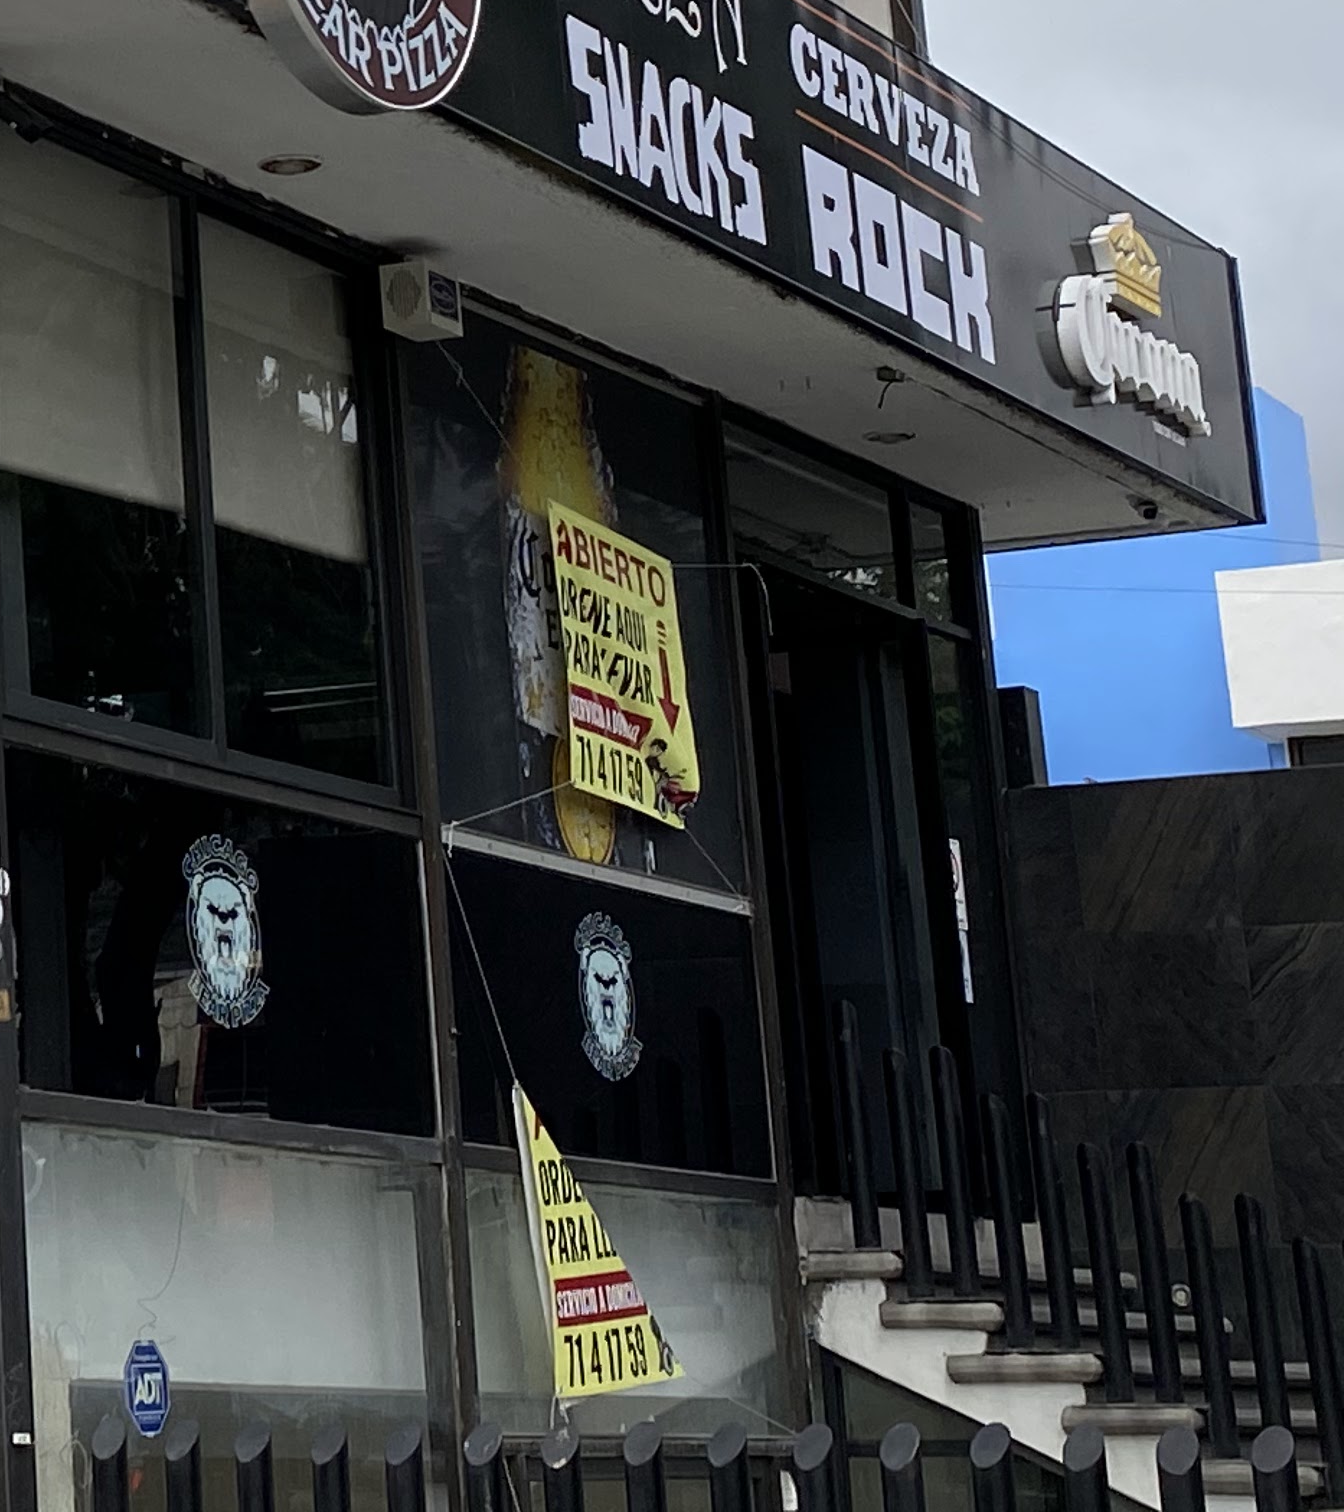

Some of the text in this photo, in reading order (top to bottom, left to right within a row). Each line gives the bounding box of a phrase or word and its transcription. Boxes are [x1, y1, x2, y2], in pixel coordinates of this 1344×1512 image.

[379, 1, 468, 92] PIZZA
[565, 15, 767, 246] SNACKS
[788, 23, 981, 197] CERVEZA
[802, 144, 996, 364] ROCK
[556, 519, 665, 607] ABIERTO
[616, 602, 648, 654] AQUI
[545, 1213, 617, 1265] PARA LL
[135, 1372, 163, 1406] ADT
